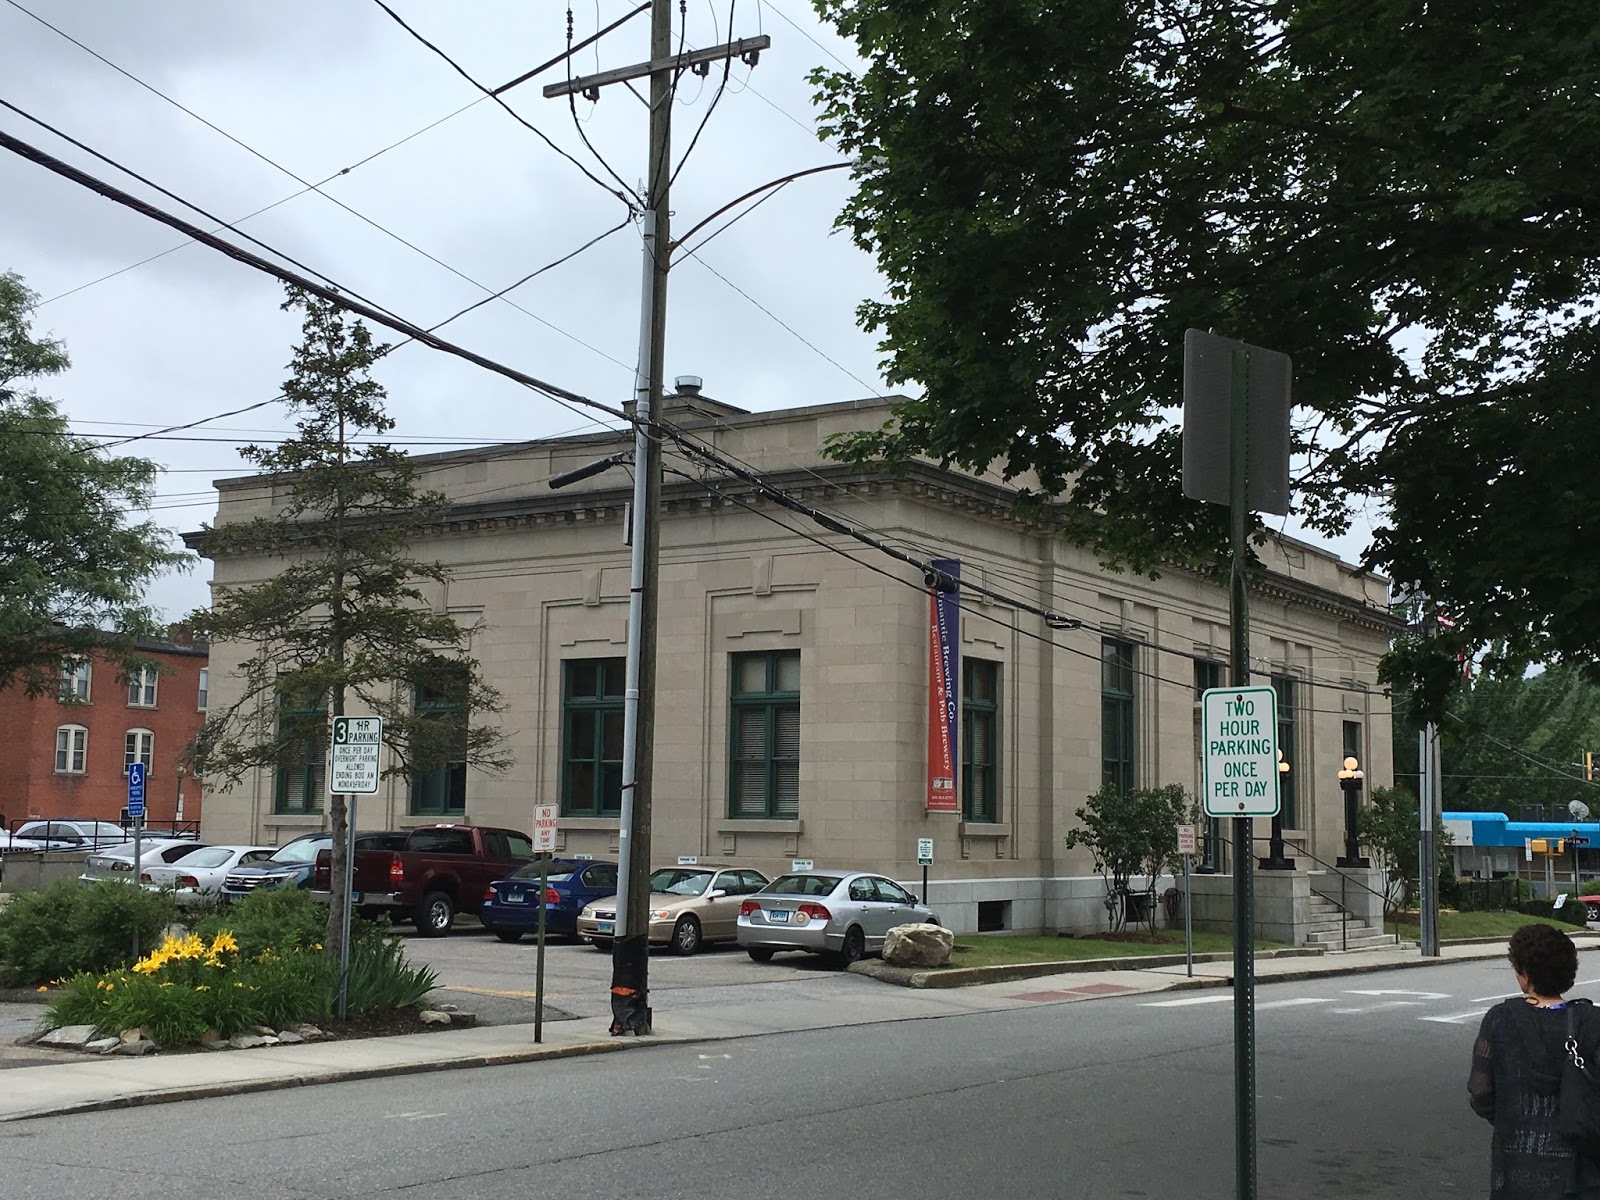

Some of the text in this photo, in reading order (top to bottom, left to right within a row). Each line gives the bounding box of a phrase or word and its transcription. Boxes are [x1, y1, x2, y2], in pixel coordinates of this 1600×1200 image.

[937, 590, 956, 723] limantic Brewing Co.
[931, 624, 950, 771] Restaurant & Pub Brewery
[1225, 700, 1255, 716] TWO
[336, 720, 370, 743] 3 HR
[1220, 720, 1260, 736] HOUR
[349, 732, 379, 743] PARKING
[339, 746, 373, 755] ONCE PER DAY
[1210, 739, 1271, 756] PARKING
[359, 754, 377, 762] PARKING
[346, 763, 365, 771] ALLOWED
[1224, 762, 1258, 778] ONCE
[1215, 781, 1268, 797] PER DAY
[541, 808, 551, 818] NO
[535, 819, 556, 828] PARKING
